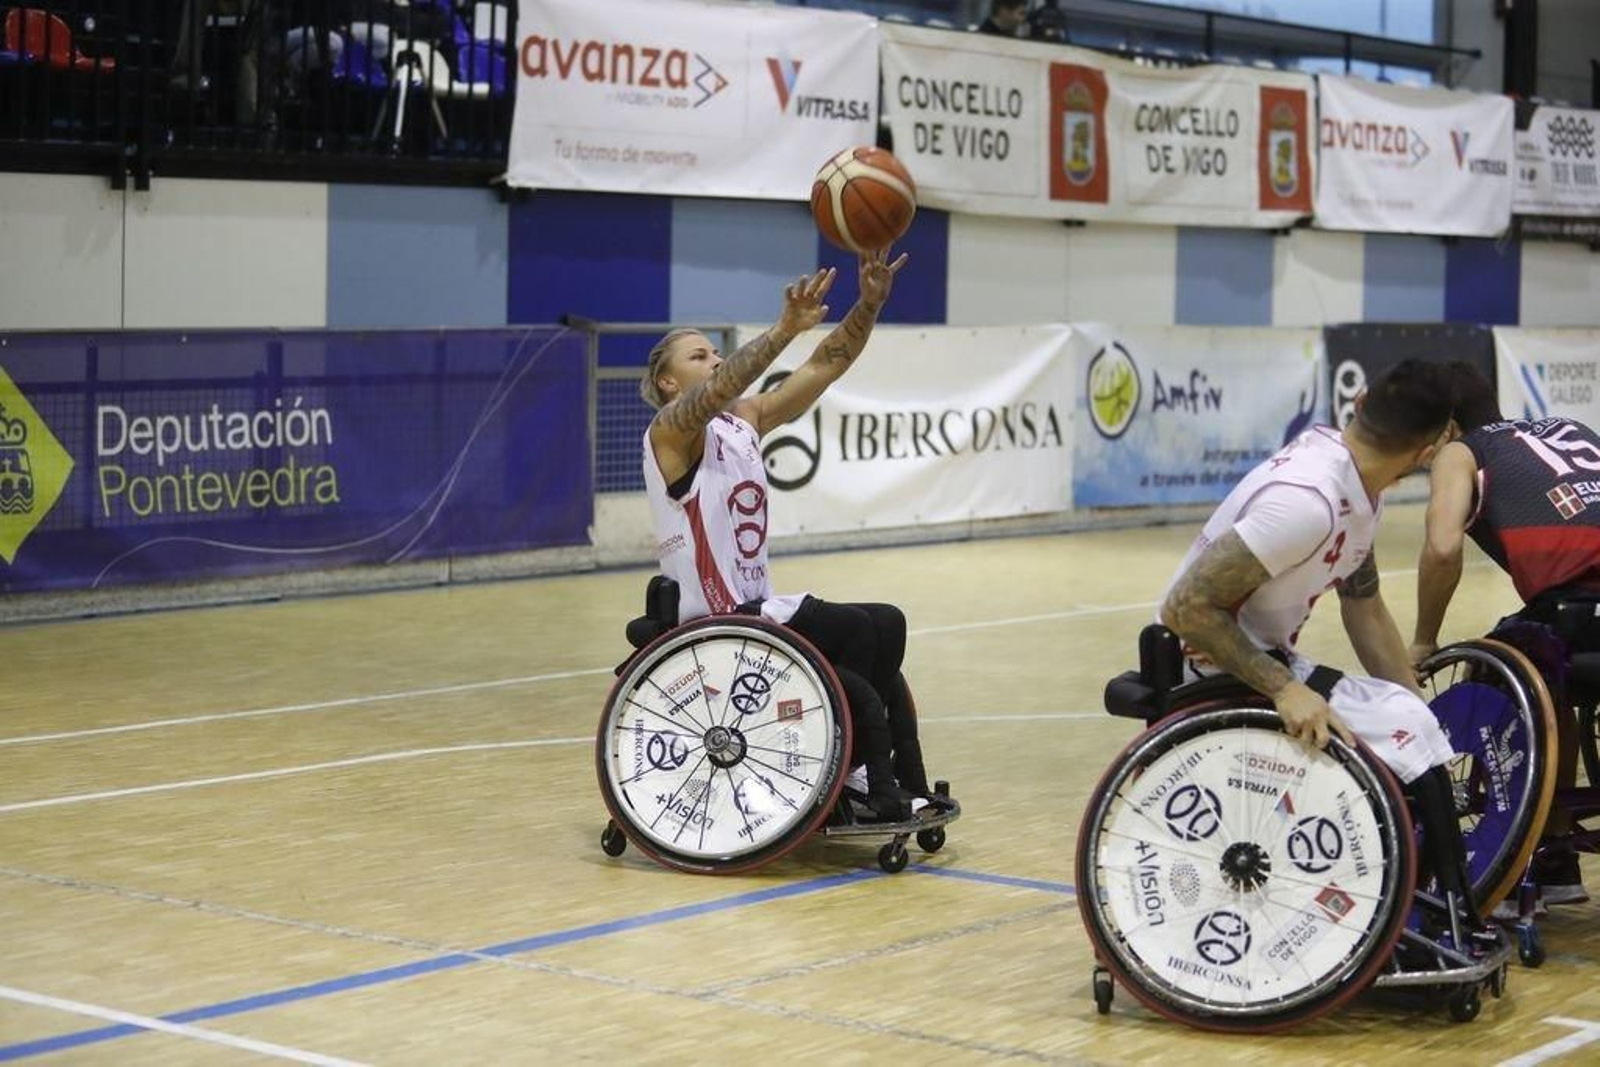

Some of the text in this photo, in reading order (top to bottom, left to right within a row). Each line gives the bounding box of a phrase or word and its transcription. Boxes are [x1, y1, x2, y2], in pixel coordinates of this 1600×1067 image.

[520, 34, 688, 88] avanza
[796, 96, 870, 122] VITRASA
[899, 75, 1023, 119] CONCELLO
[1134, 103, 1240, 138] CONCELLO
[1321, 117, 1408, 155] avanza
[622, 144, 638, 162] de
[914, 122, 1010, 161] DE VIGO
[1146, 146, 1228, 177] DE VIGO
[1152, 368, 1224, 414] Amfiv
[97, 396, 332, 466] Deputación
[839, 401, 1063, 462] IBERCONSA
[1514, 424, 1600, 477] 15
[100, 456, 340, 518] Pontevedra
[1133, 750, 1202, 814] IBERCONSA
[1227, 777, 1278, 796] VITRASA
[1249, 757, 1306, 778] avanza
[1167, 955, 1253, 990] IBERCONSA
